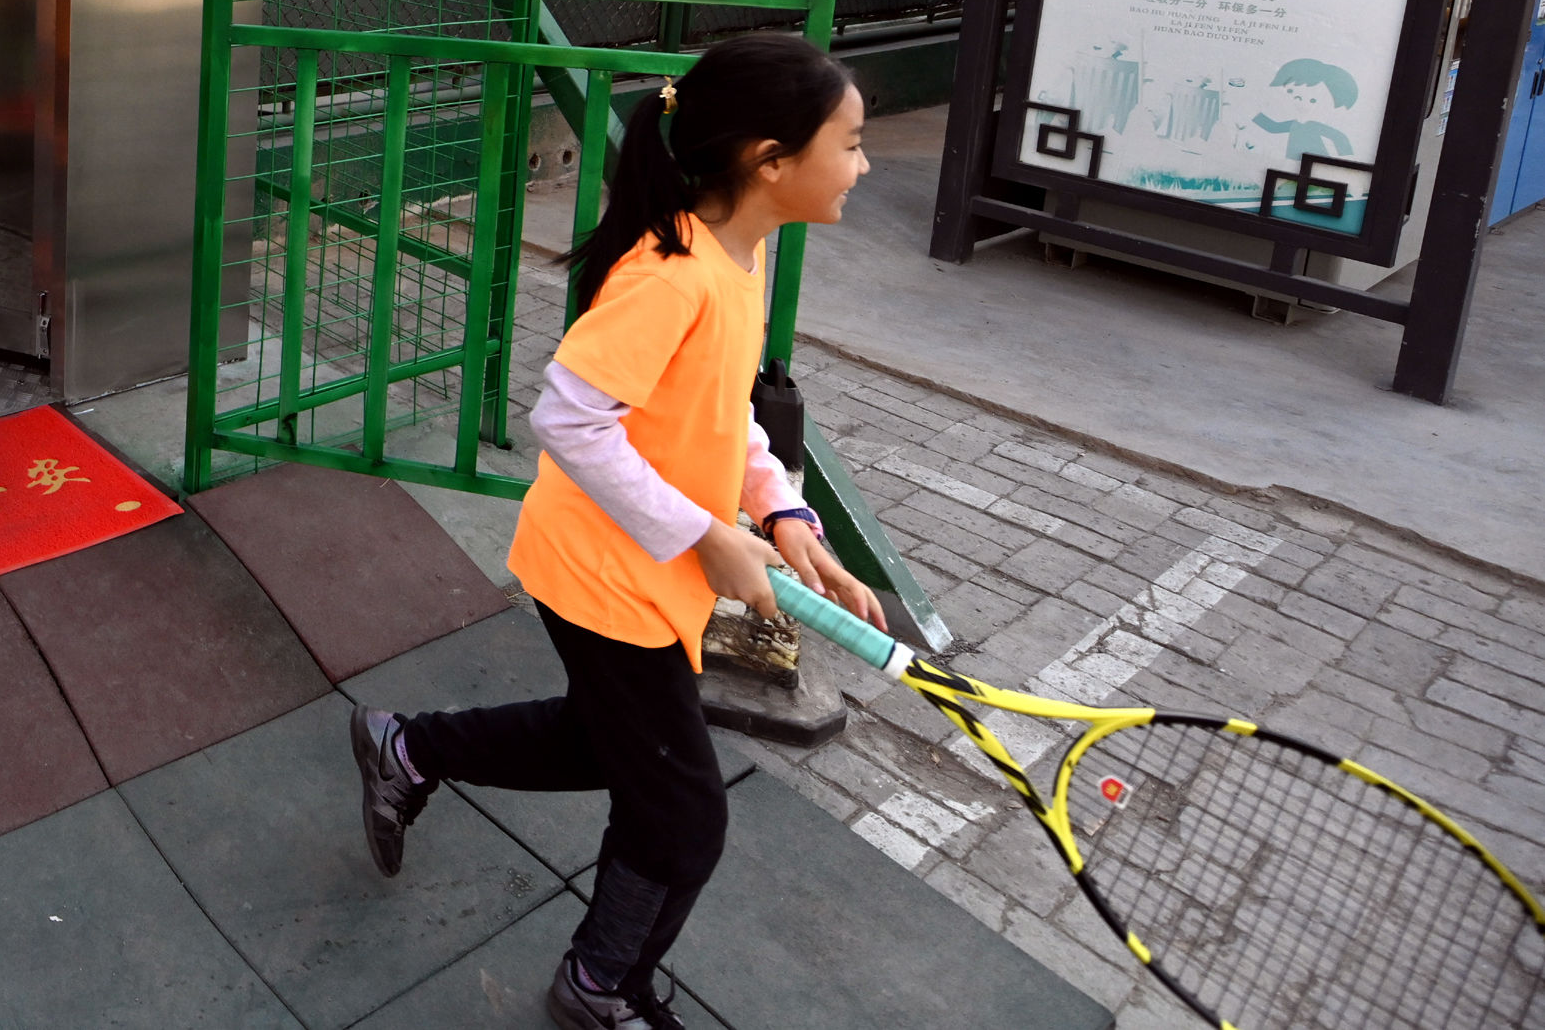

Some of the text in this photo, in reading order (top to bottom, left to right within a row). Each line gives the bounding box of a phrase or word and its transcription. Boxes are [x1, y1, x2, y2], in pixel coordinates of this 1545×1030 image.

[1218, 1, 1287, 18] 环保多一分
